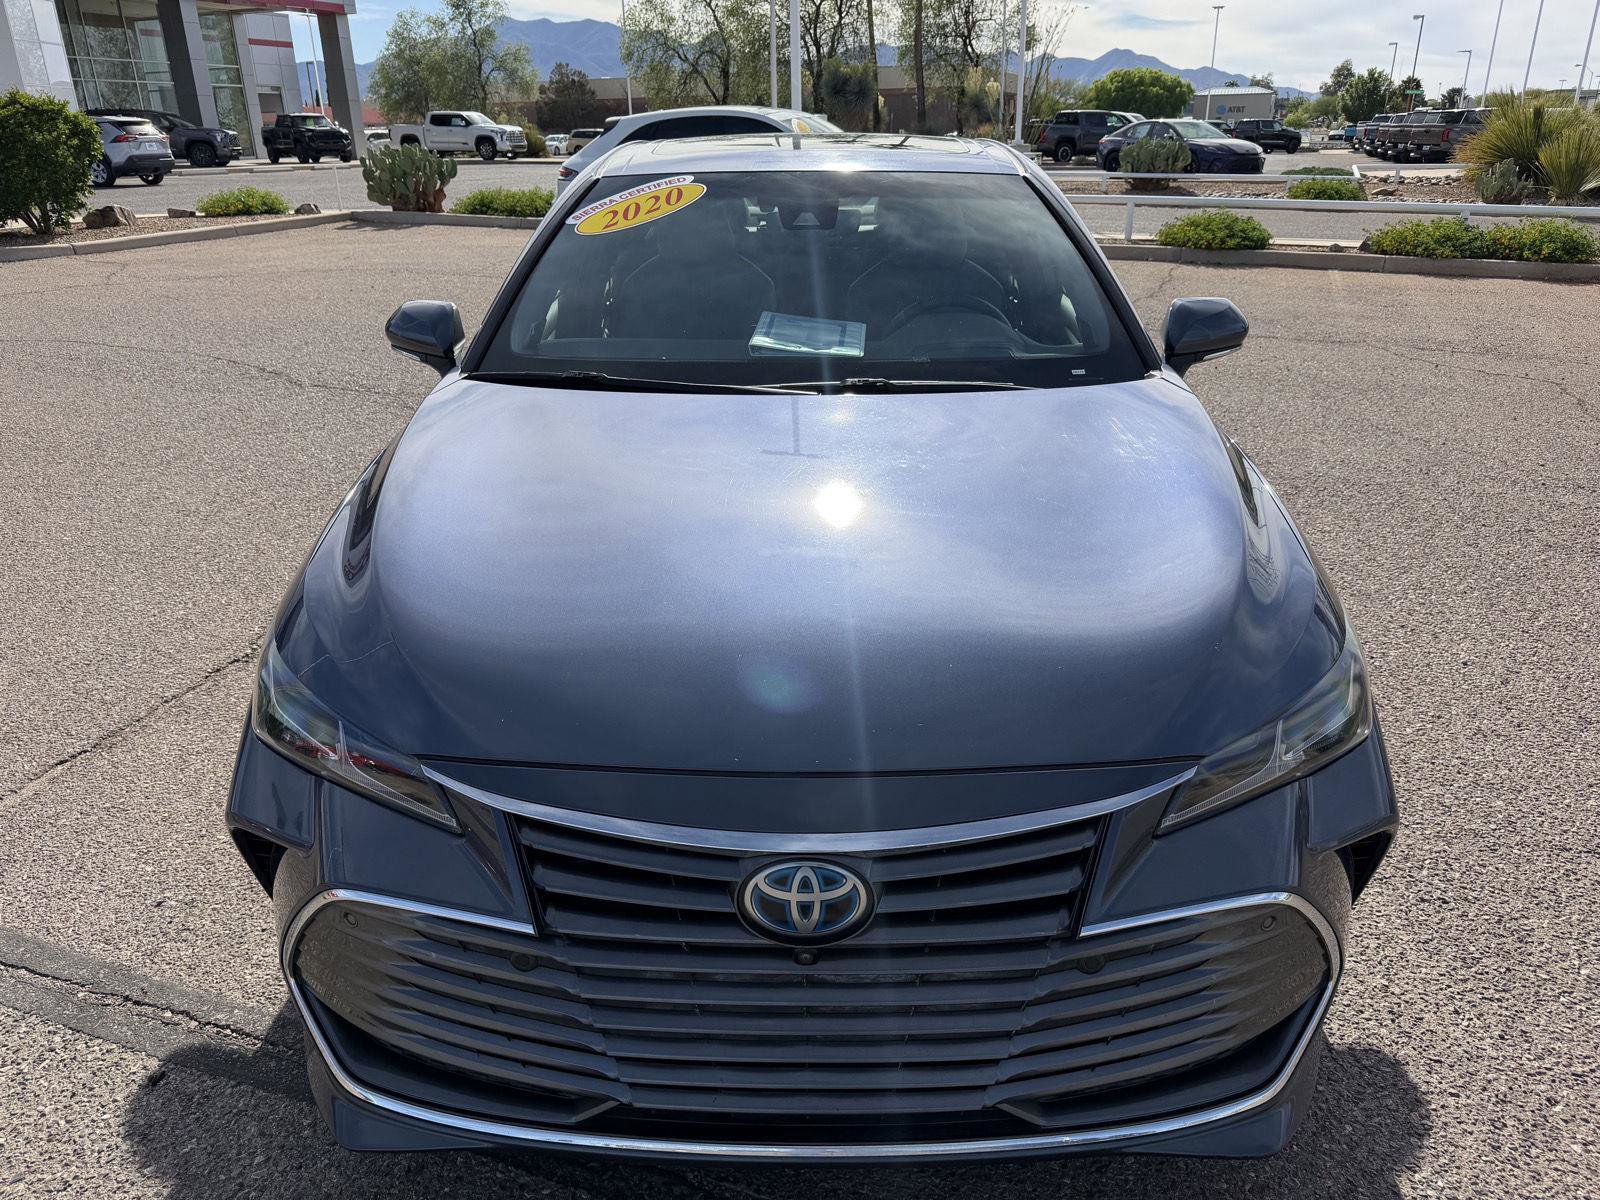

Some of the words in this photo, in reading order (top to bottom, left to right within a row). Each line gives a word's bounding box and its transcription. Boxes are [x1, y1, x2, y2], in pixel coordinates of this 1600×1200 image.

[1227, 105, 1246, 113] AT&T
[571, 198, 619, 222] SIERRA
[618, 176, 687, 201] CERTIFIED
[601, 187, 684, 231] 2020
